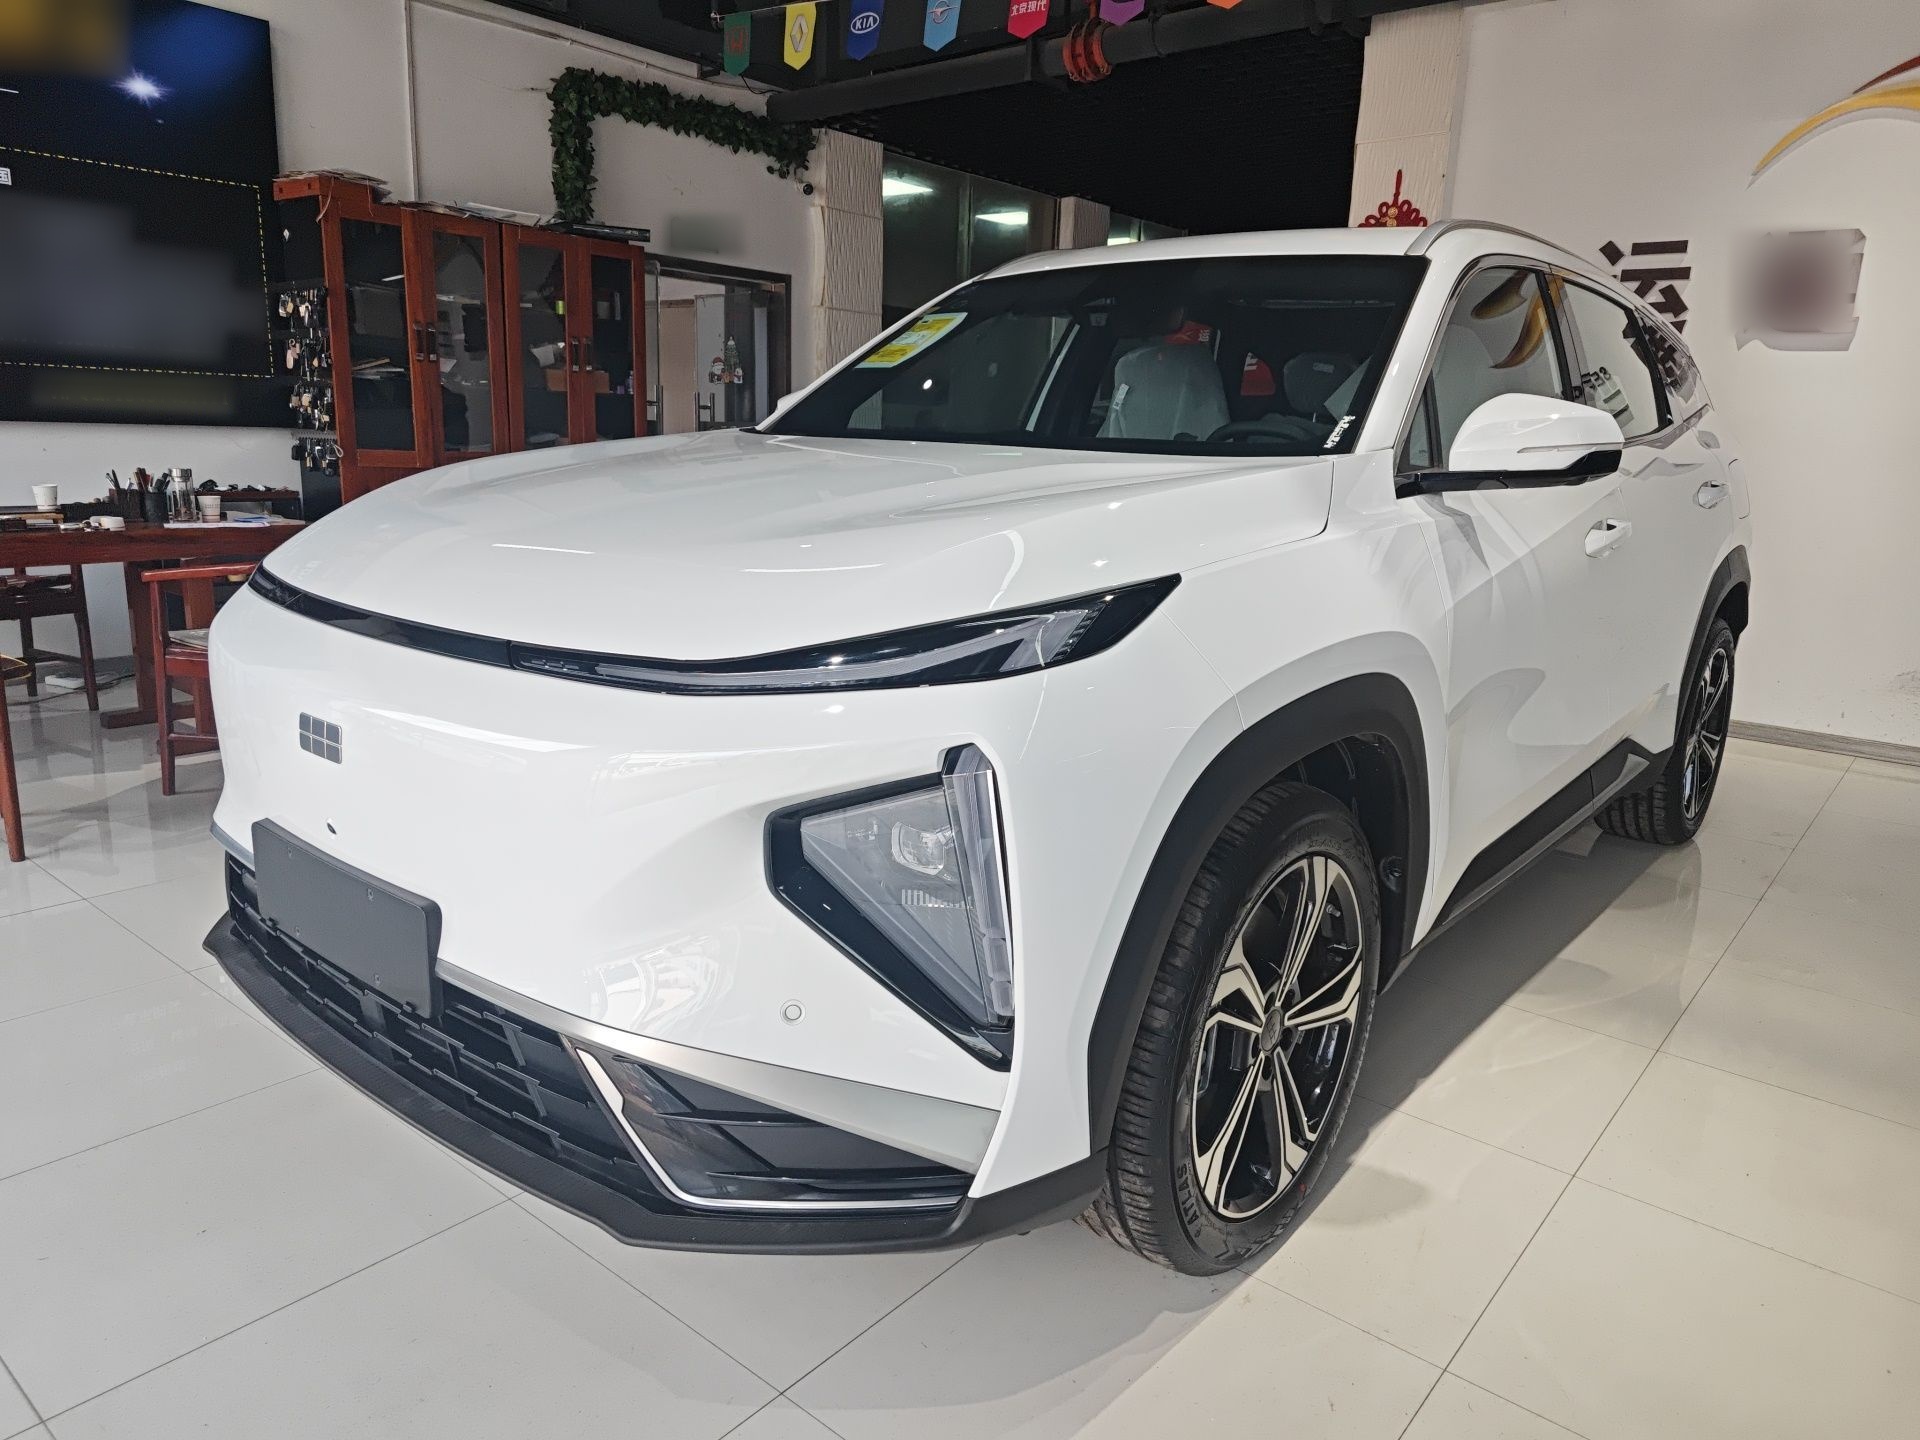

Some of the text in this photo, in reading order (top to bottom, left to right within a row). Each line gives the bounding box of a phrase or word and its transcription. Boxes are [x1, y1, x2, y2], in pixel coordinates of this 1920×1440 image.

[1010, 0, 1047, 17] 北京现代
[855, 16, 874, 30] KIA
[1177, 1163, 1200, 1226] ATLAS
